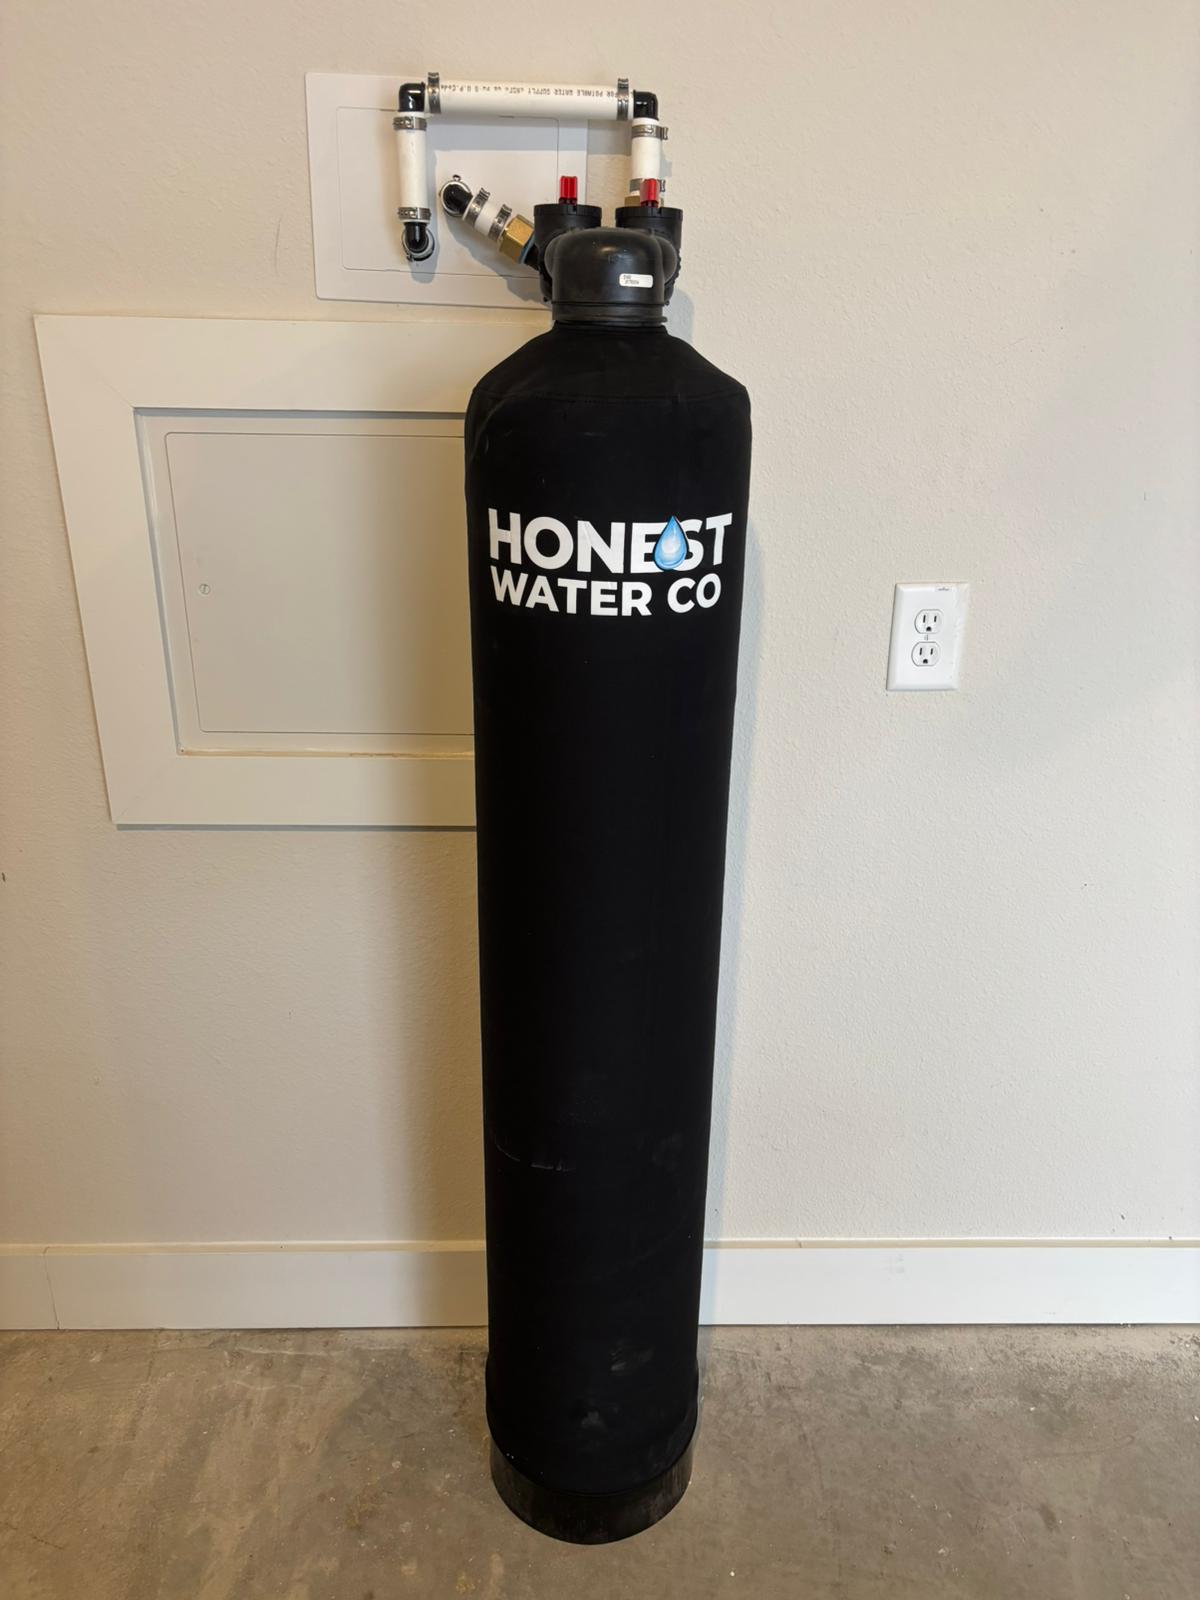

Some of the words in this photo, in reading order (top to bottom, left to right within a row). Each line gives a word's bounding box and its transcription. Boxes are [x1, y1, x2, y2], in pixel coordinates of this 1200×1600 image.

[528, 87, 550, 96] SUPPLY
[554, 88, 573, 96] WATER
[488, 508, 733, 574] HONEST
[490, 565, 653, 617] WATER
[667, 572, 722, 614] CO
